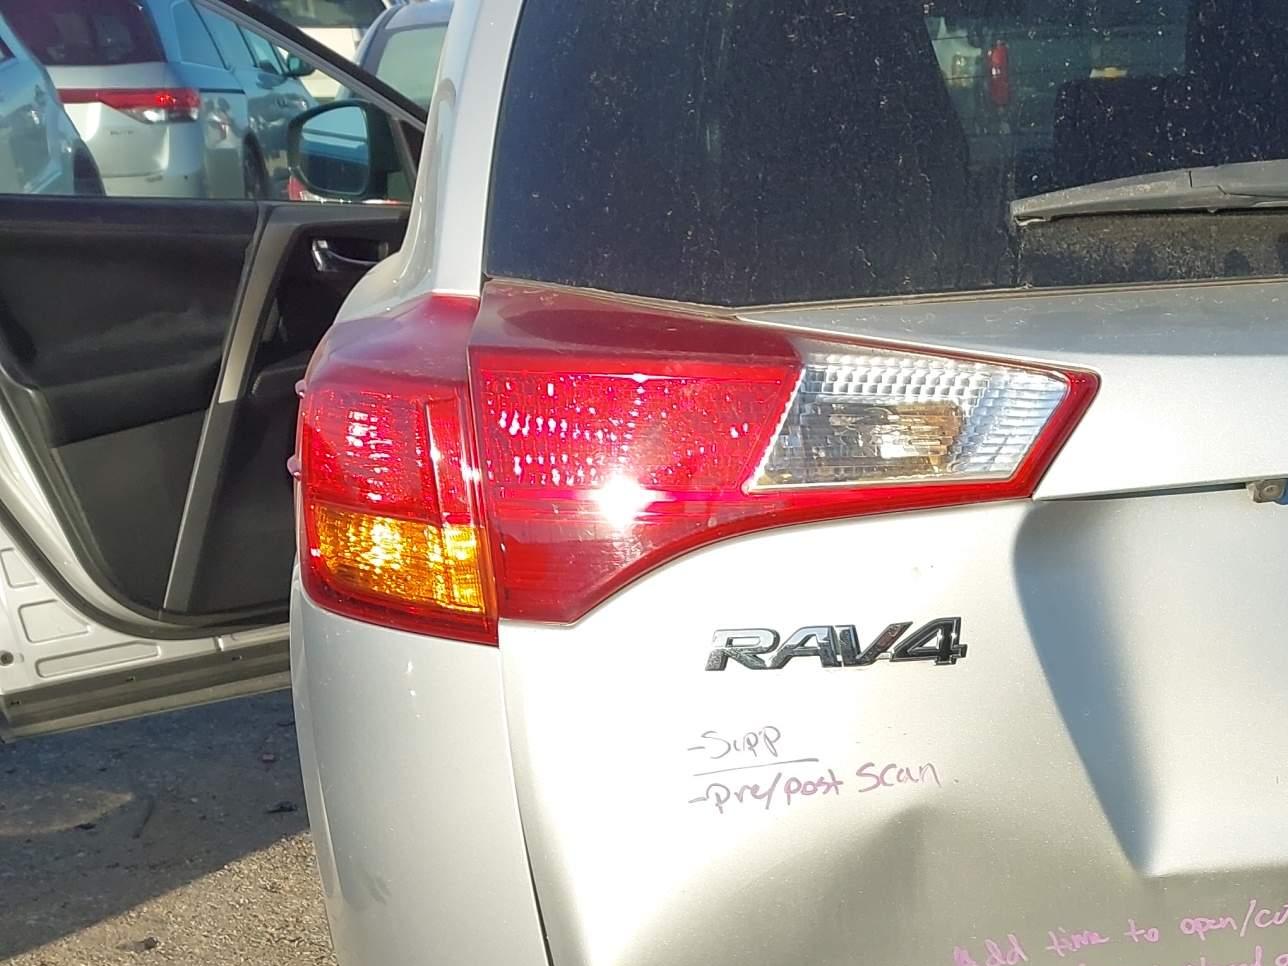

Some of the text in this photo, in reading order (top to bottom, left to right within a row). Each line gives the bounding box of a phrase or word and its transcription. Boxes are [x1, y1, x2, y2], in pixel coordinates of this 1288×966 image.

[705, 616, 968, 671] RAV4
[1045, 925, 1110, 957] time
[1124, 918, 1159, 942] to
